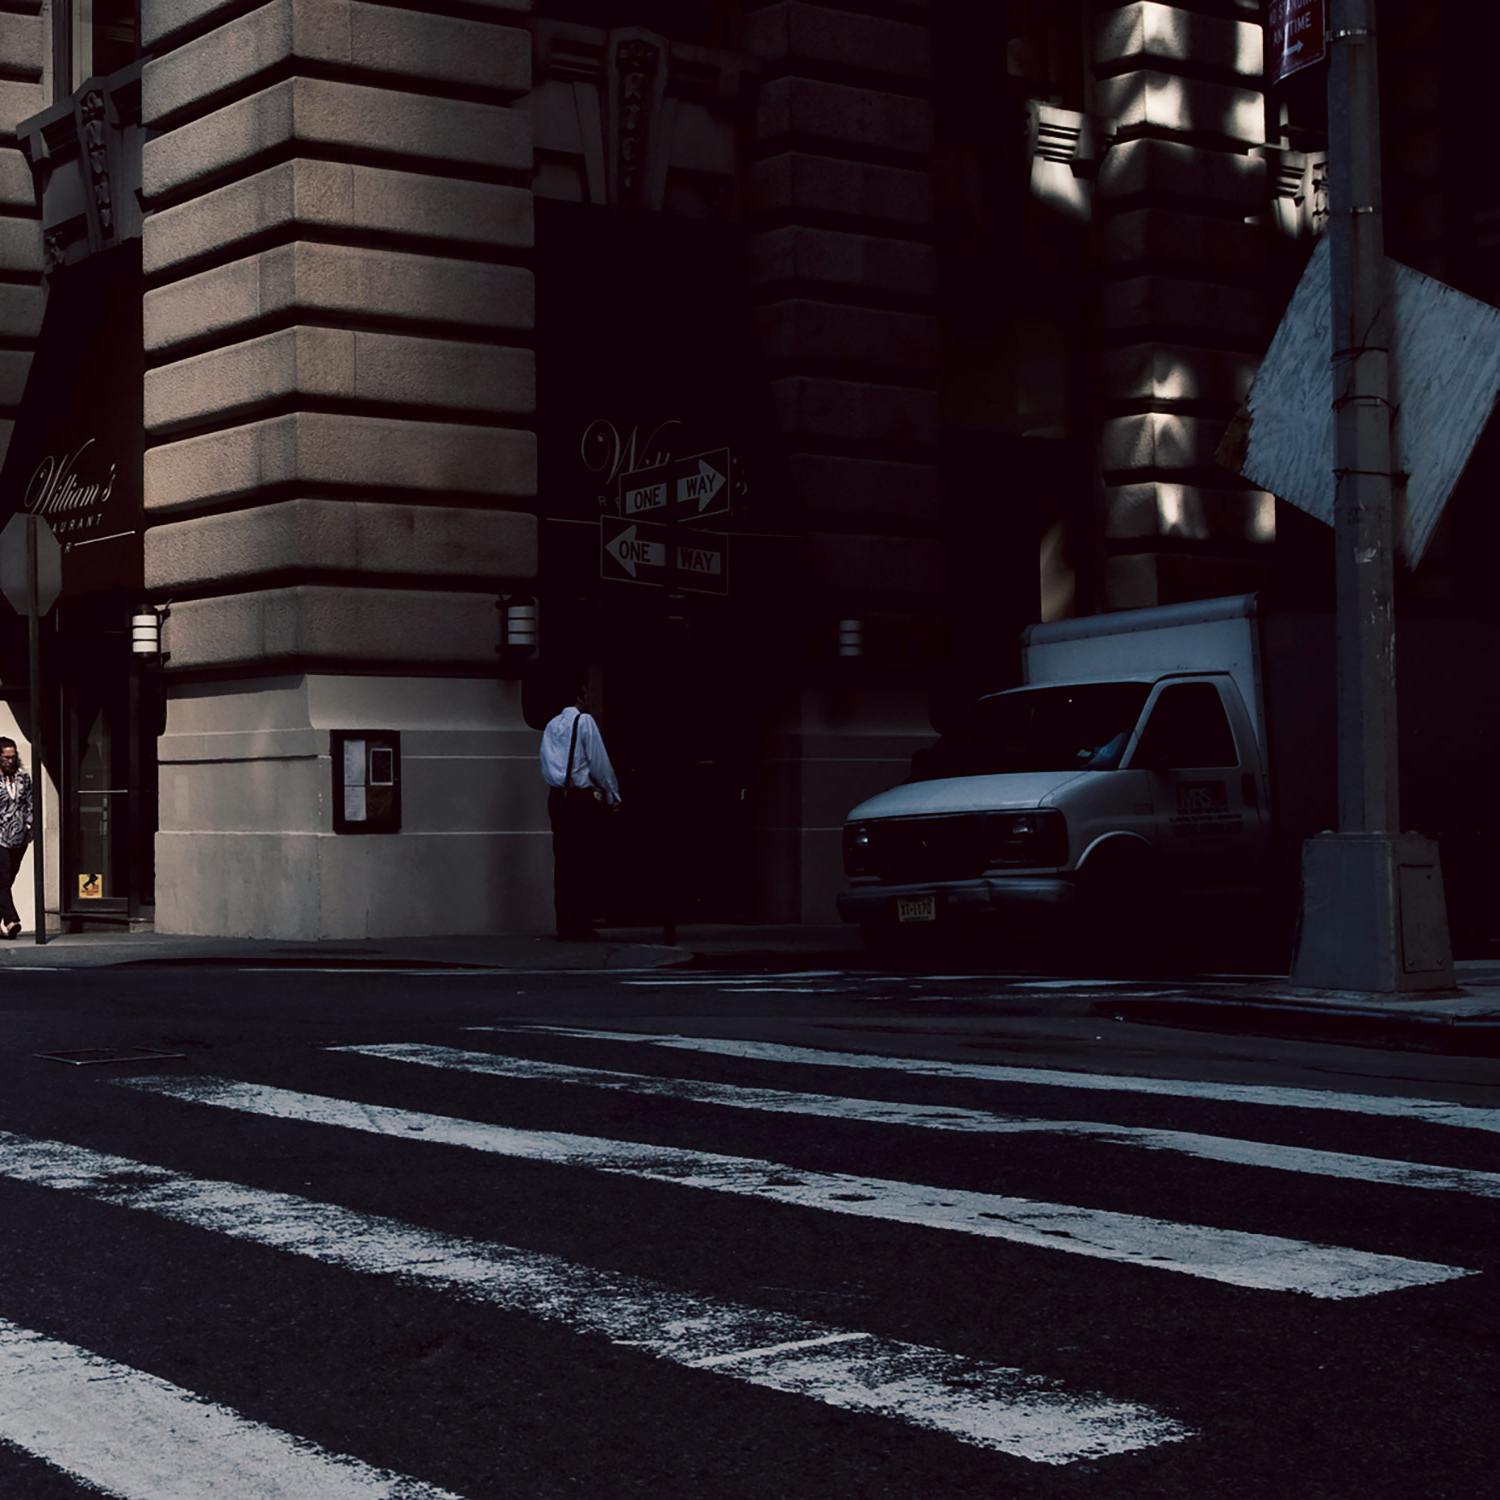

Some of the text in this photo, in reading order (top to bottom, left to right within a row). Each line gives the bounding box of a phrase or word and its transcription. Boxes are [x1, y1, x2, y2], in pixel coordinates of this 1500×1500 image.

[24, 437, 117, 516] William's
[634, 486, 661, 510] ONE
[686, 472, 717, 498] WAY
[52, 513, 103, 533] AURANT
[619, 540, 715, 571] ONE WAY
